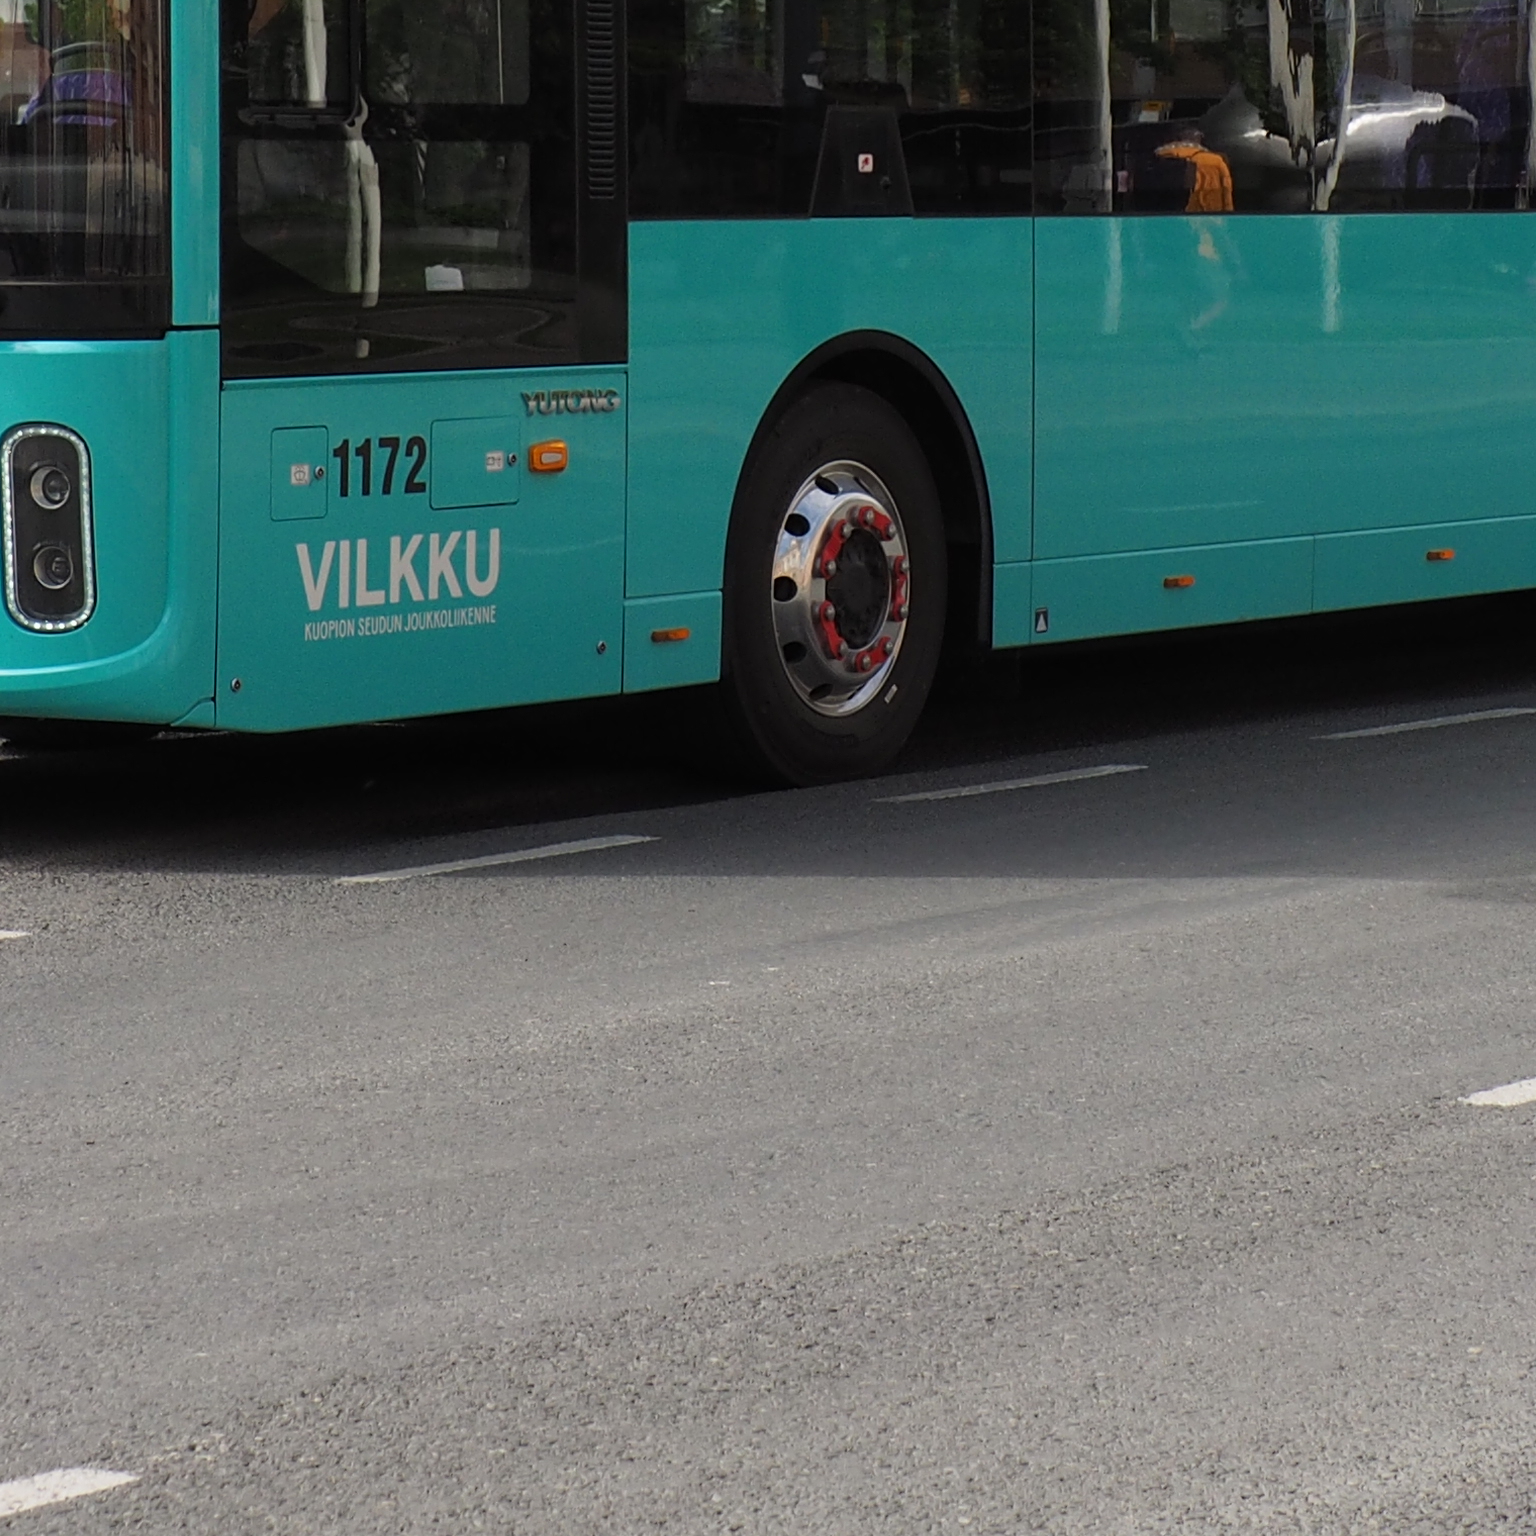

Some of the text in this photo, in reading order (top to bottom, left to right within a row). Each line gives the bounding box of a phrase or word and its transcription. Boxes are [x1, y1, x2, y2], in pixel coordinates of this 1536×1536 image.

[521, 388, 621, 417] YUTONG
[332, 435, 427, 498] 1172
[295, 528, 500, 611] VILKKU
[305, 605, 497, 641] KUOPION SEUDUN JOUKKOLIIKENNE
